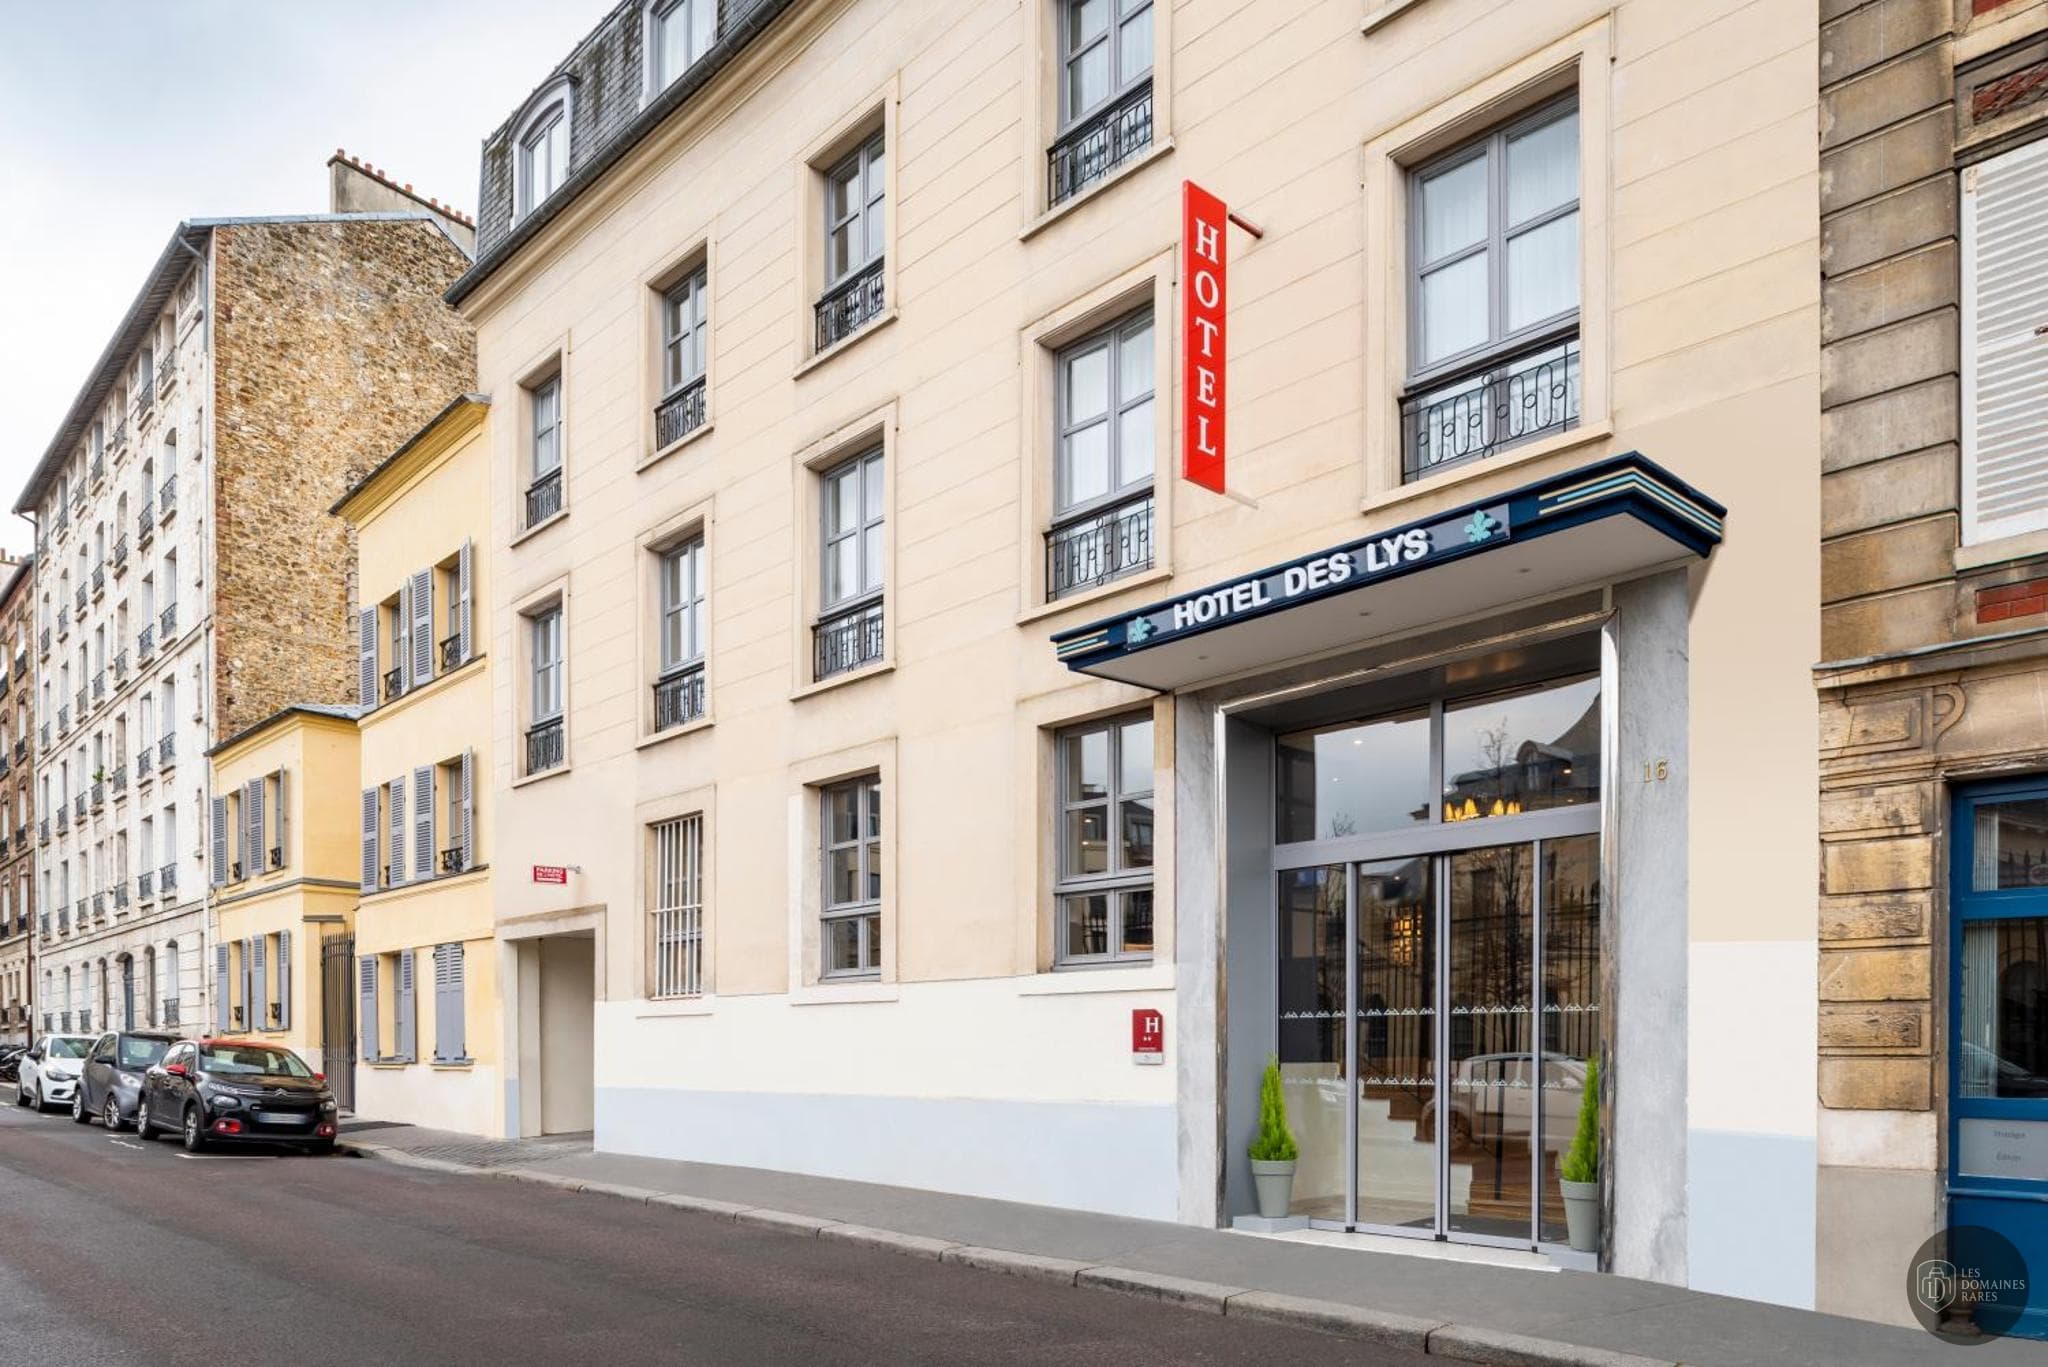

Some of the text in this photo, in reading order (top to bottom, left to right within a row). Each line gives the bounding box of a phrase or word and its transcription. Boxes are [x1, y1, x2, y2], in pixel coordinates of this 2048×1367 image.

[1195, 218, 1219, 457] HOTEL
[1173, 529, 1429, 630] HOTEL DES LYS
[1644, 760, 1668, 783] 16
[1145, 1017, 1160, 1033] H
